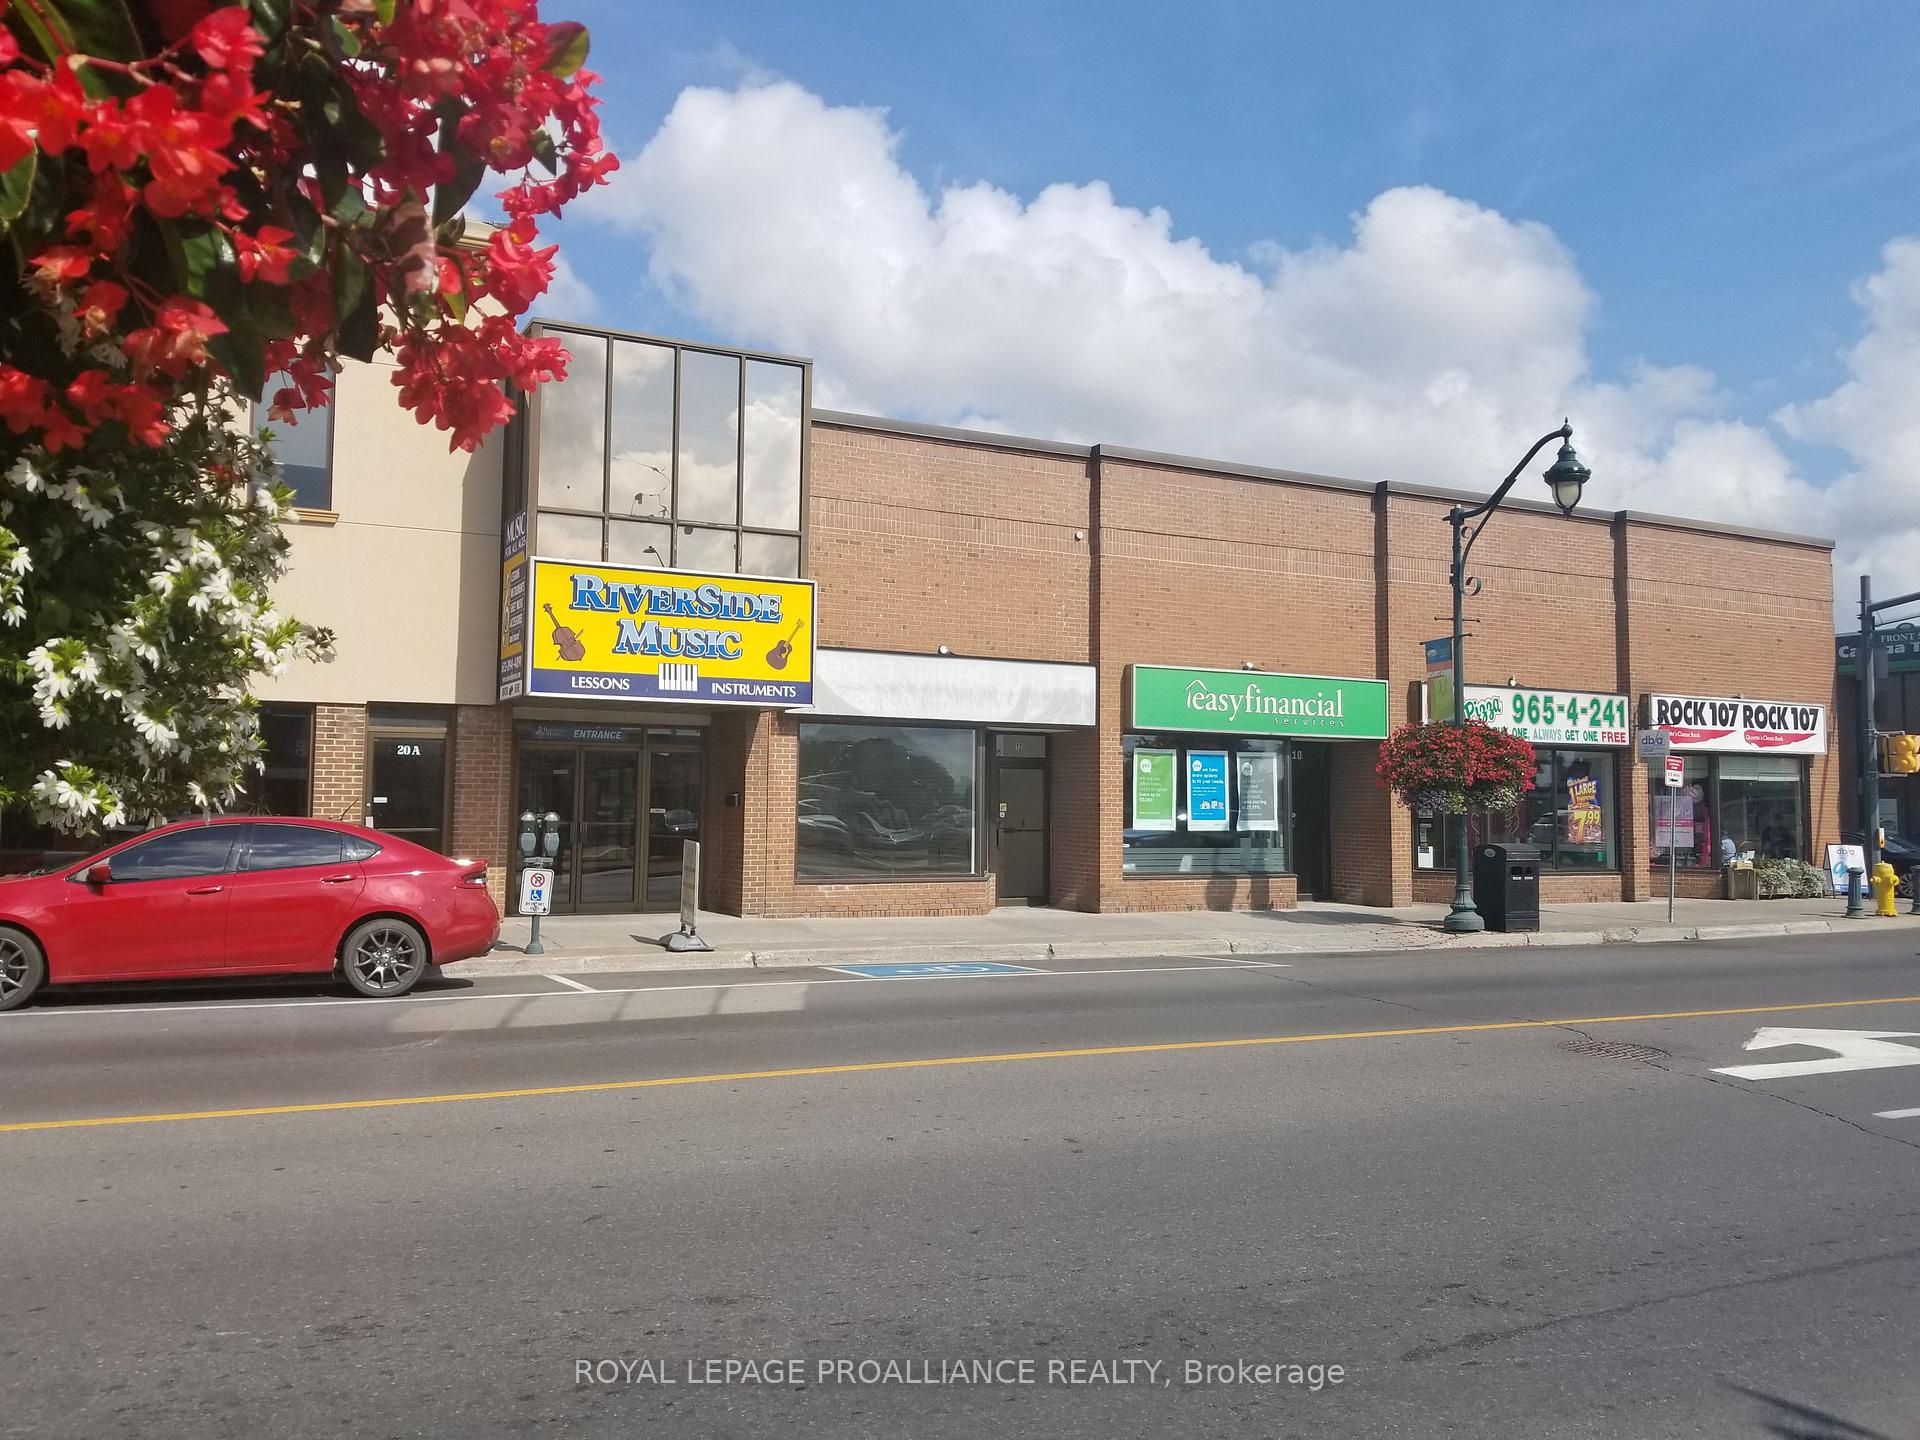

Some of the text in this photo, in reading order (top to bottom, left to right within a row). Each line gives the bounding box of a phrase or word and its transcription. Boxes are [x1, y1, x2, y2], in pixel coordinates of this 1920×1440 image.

[1881, 632, 1915, 643] FRONT
[571, 676, 630, 691] LESSONS
[711, 682, 797, 697] INSTRUMENTS
[1189, 683, 1344, 722] easyfinancial
[1464, 694, 1626, 728] Pizza 965-4-241
[1657, 699, 1819, 731] ROCK 107 ROCK 107
[1274, 716, 1345, 728] services
[573, 729, 622, 740] ENTRANCE
[1533, 728, 1562, 741] ALWAYS
[1565, 729, 1579, 741] GET
[1583, 730, 1598, 742] ONE
[1601, 731, 1626, 743] FREE
[397, 744, 421, 756] 20 A
[1291, 750, 1303, 760] 10
[1574, 781, 1597, 796] LARGE
